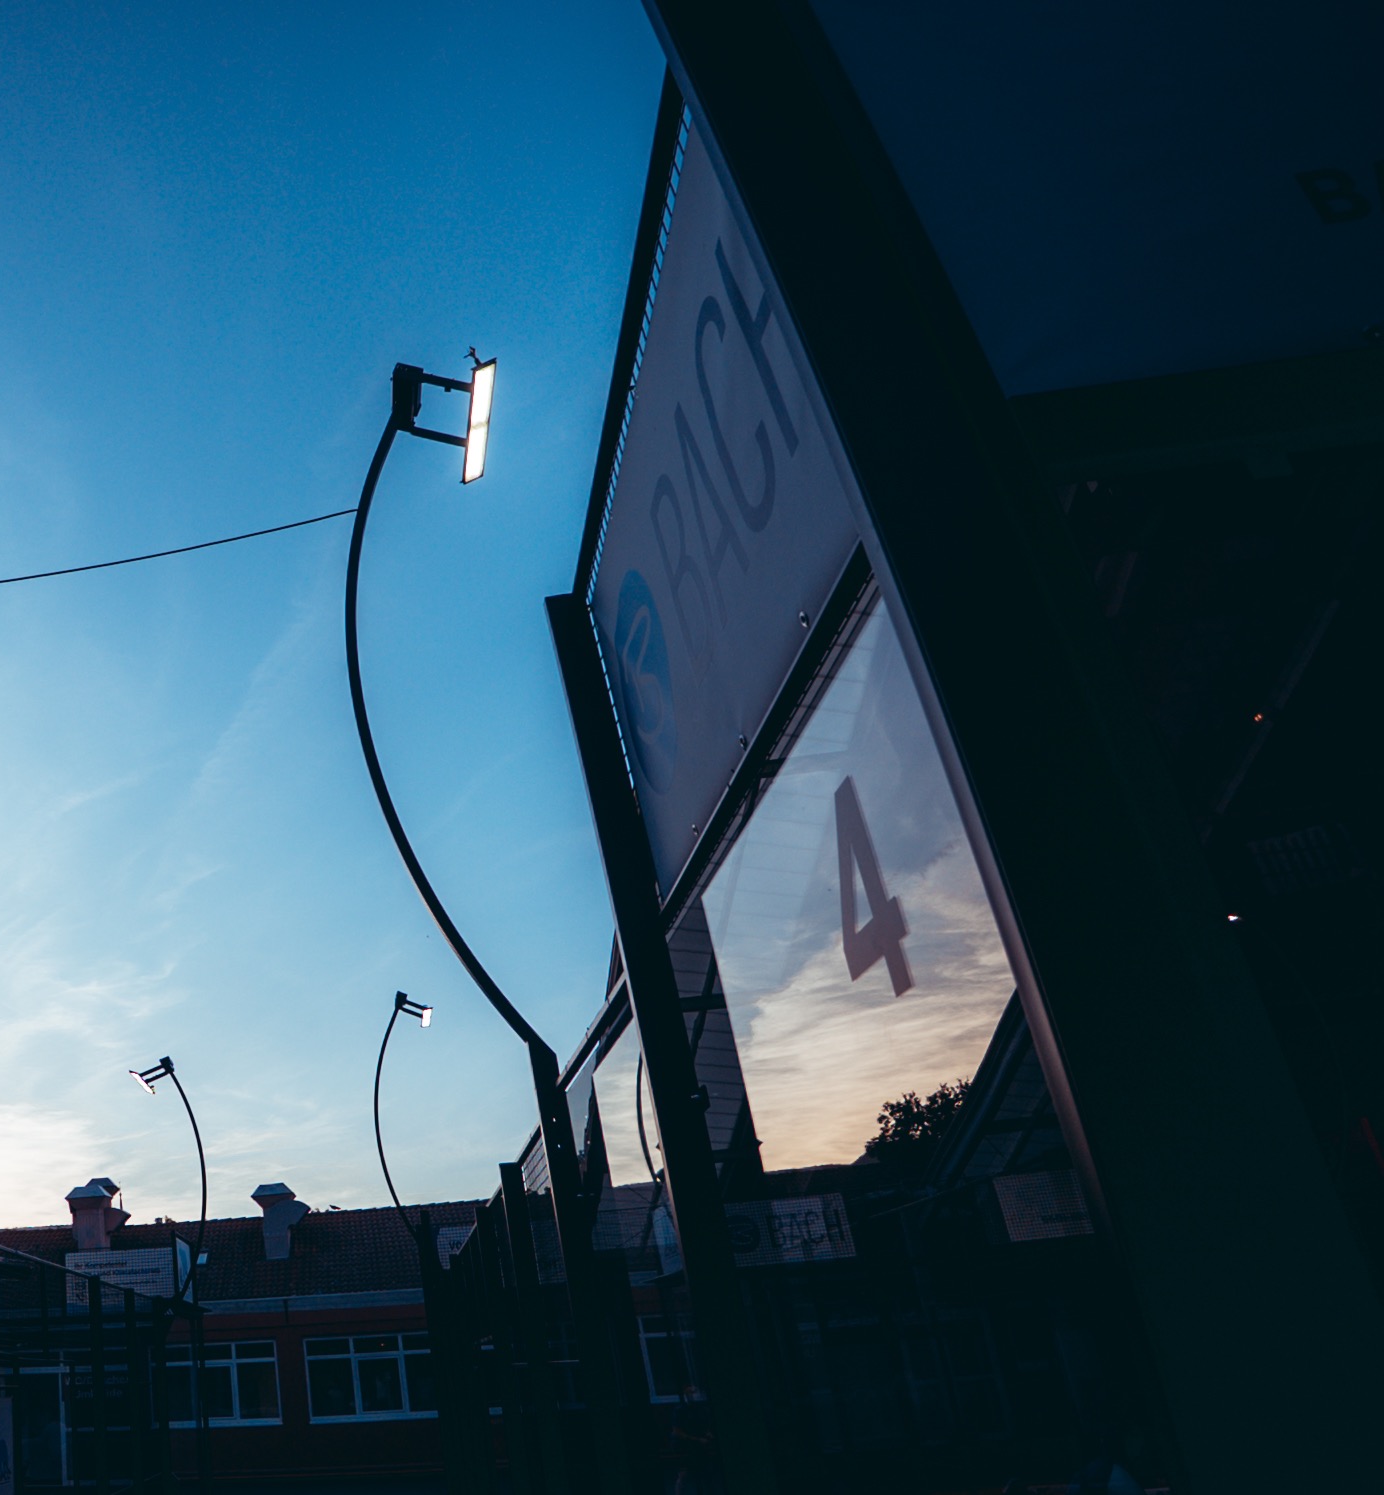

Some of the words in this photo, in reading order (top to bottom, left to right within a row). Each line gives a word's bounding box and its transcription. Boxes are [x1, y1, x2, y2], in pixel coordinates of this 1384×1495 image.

[1293, 159, 1384, 225] B
[834, 775, 914, 998] 4
[765, 1209, 845, 1248] BACH
